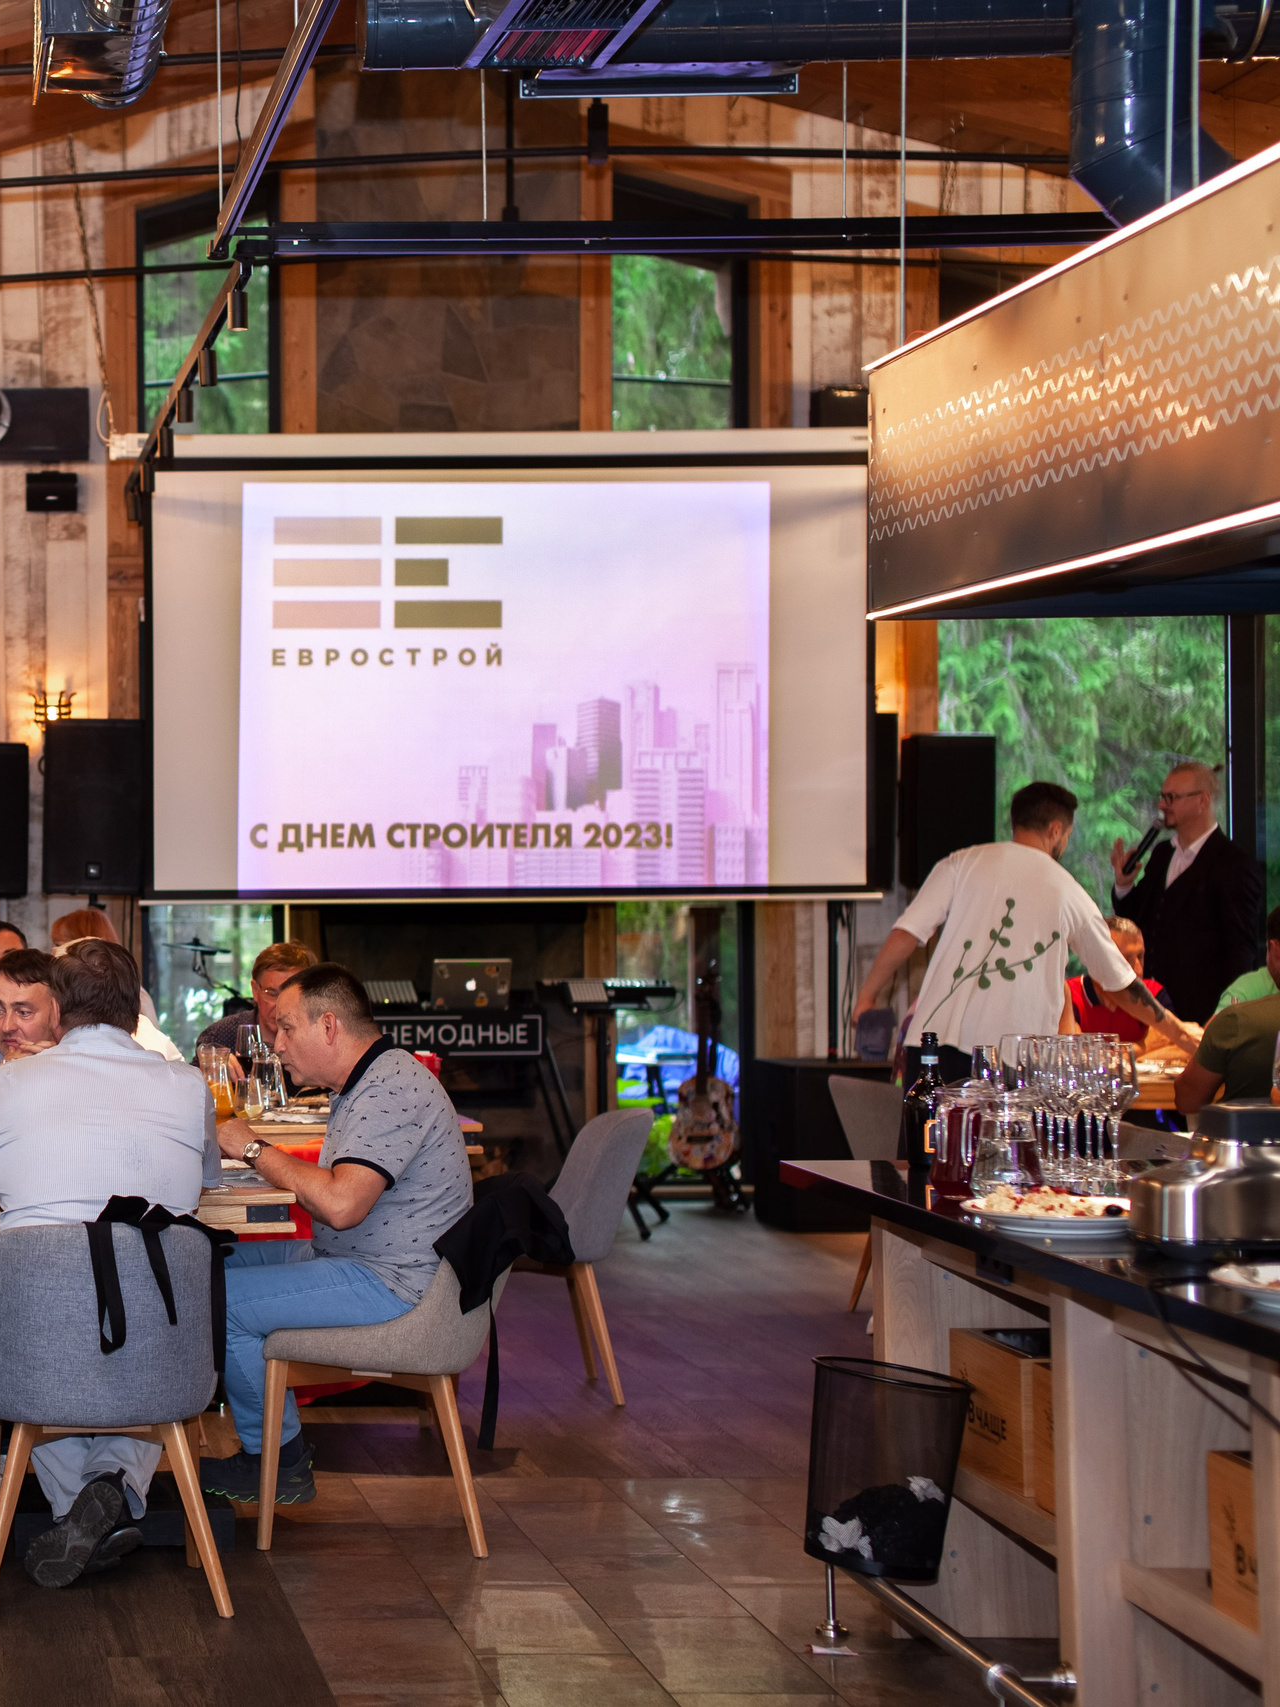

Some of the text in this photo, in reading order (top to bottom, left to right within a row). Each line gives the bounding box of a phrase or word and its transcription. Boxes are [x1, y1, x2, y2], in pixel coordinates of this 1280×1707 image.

[271, 642, 503, 667] ЕВРОСТРОЙ
[249, 822, 673, 852] С ДНЕМ СТРОИТЕЛЯ 2023!
